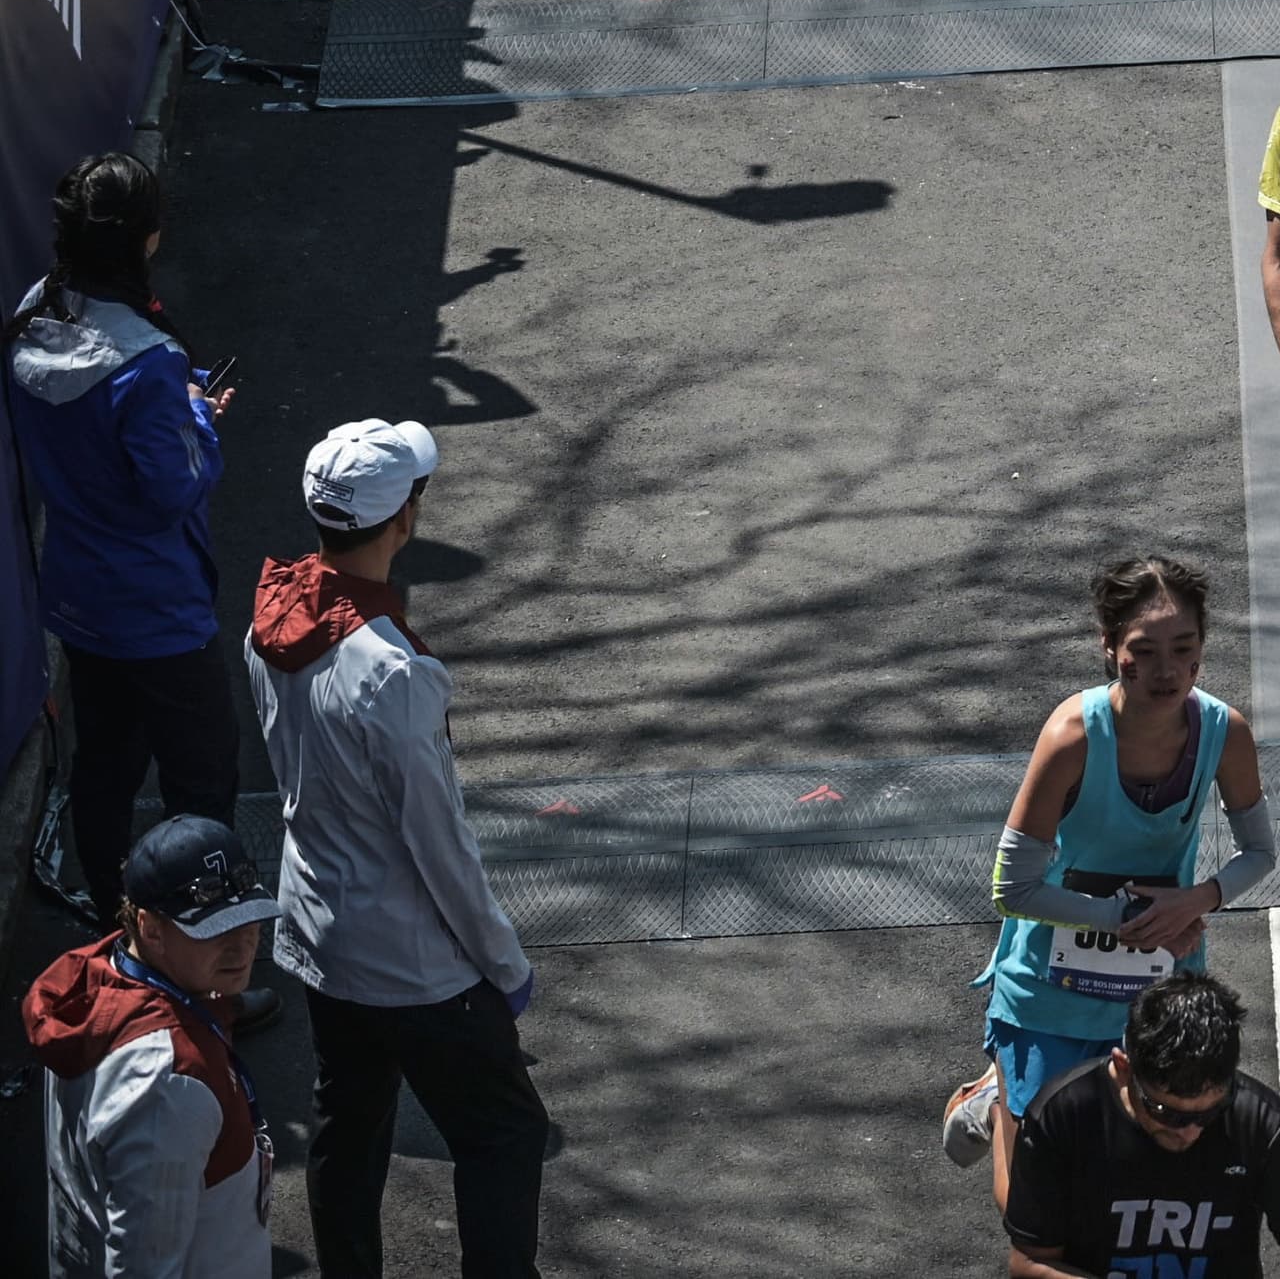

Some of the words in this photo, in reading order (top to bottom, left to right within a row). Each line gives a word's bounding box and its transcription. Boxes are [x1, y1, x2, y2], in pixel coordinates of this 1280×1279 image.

[1056, 951, 1064, 962] 2
[1093, 980, 1122, 990] BOSTON
[1110, 1199, 1234, 1249] TRI-
